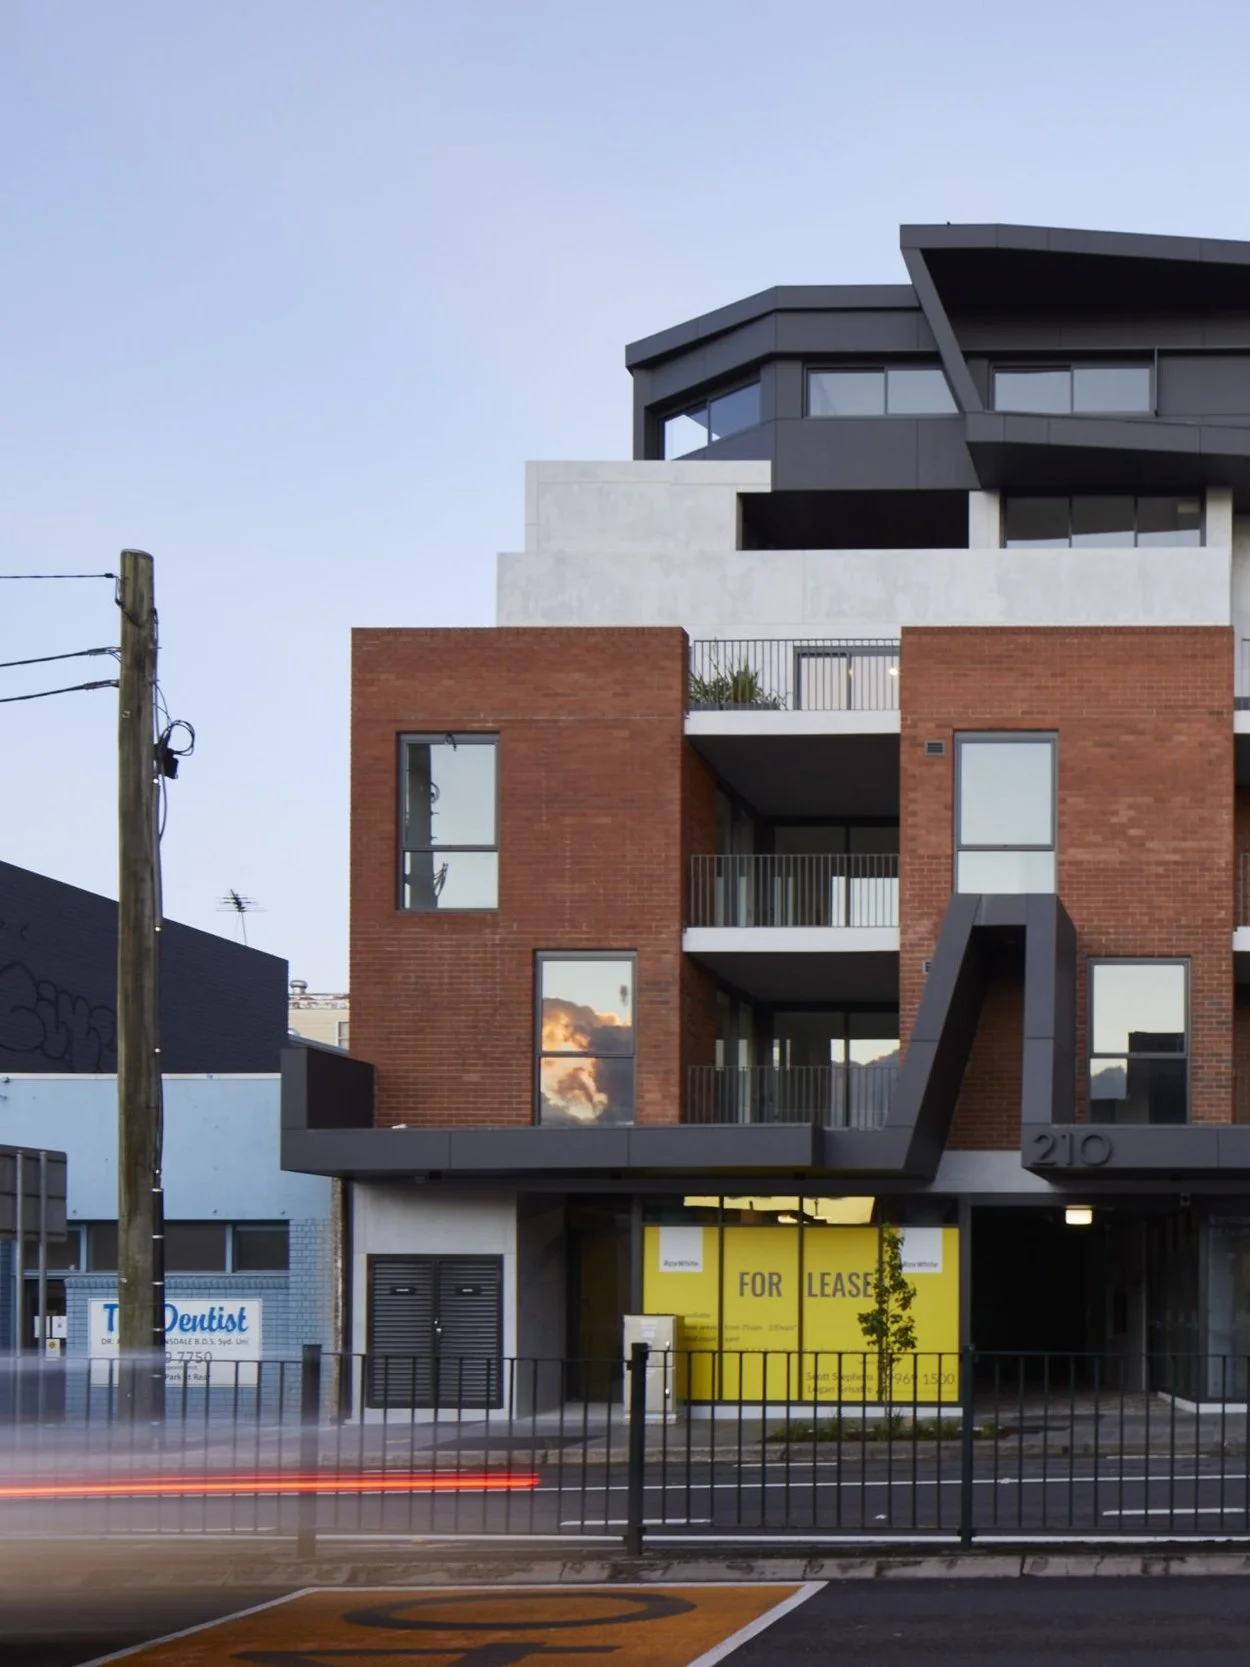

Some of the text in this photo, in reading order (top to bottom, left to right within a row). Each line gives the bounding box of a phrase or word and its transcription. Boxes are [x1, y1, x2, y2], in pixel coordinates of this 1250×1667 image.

[1031, 1132, 1114, 1167] 210
[738, 1272, 874, 1298] FOR LEASE
[165, 1303, 249, 1333] Dentist
[177, 1351, 213, 1363] 7750
